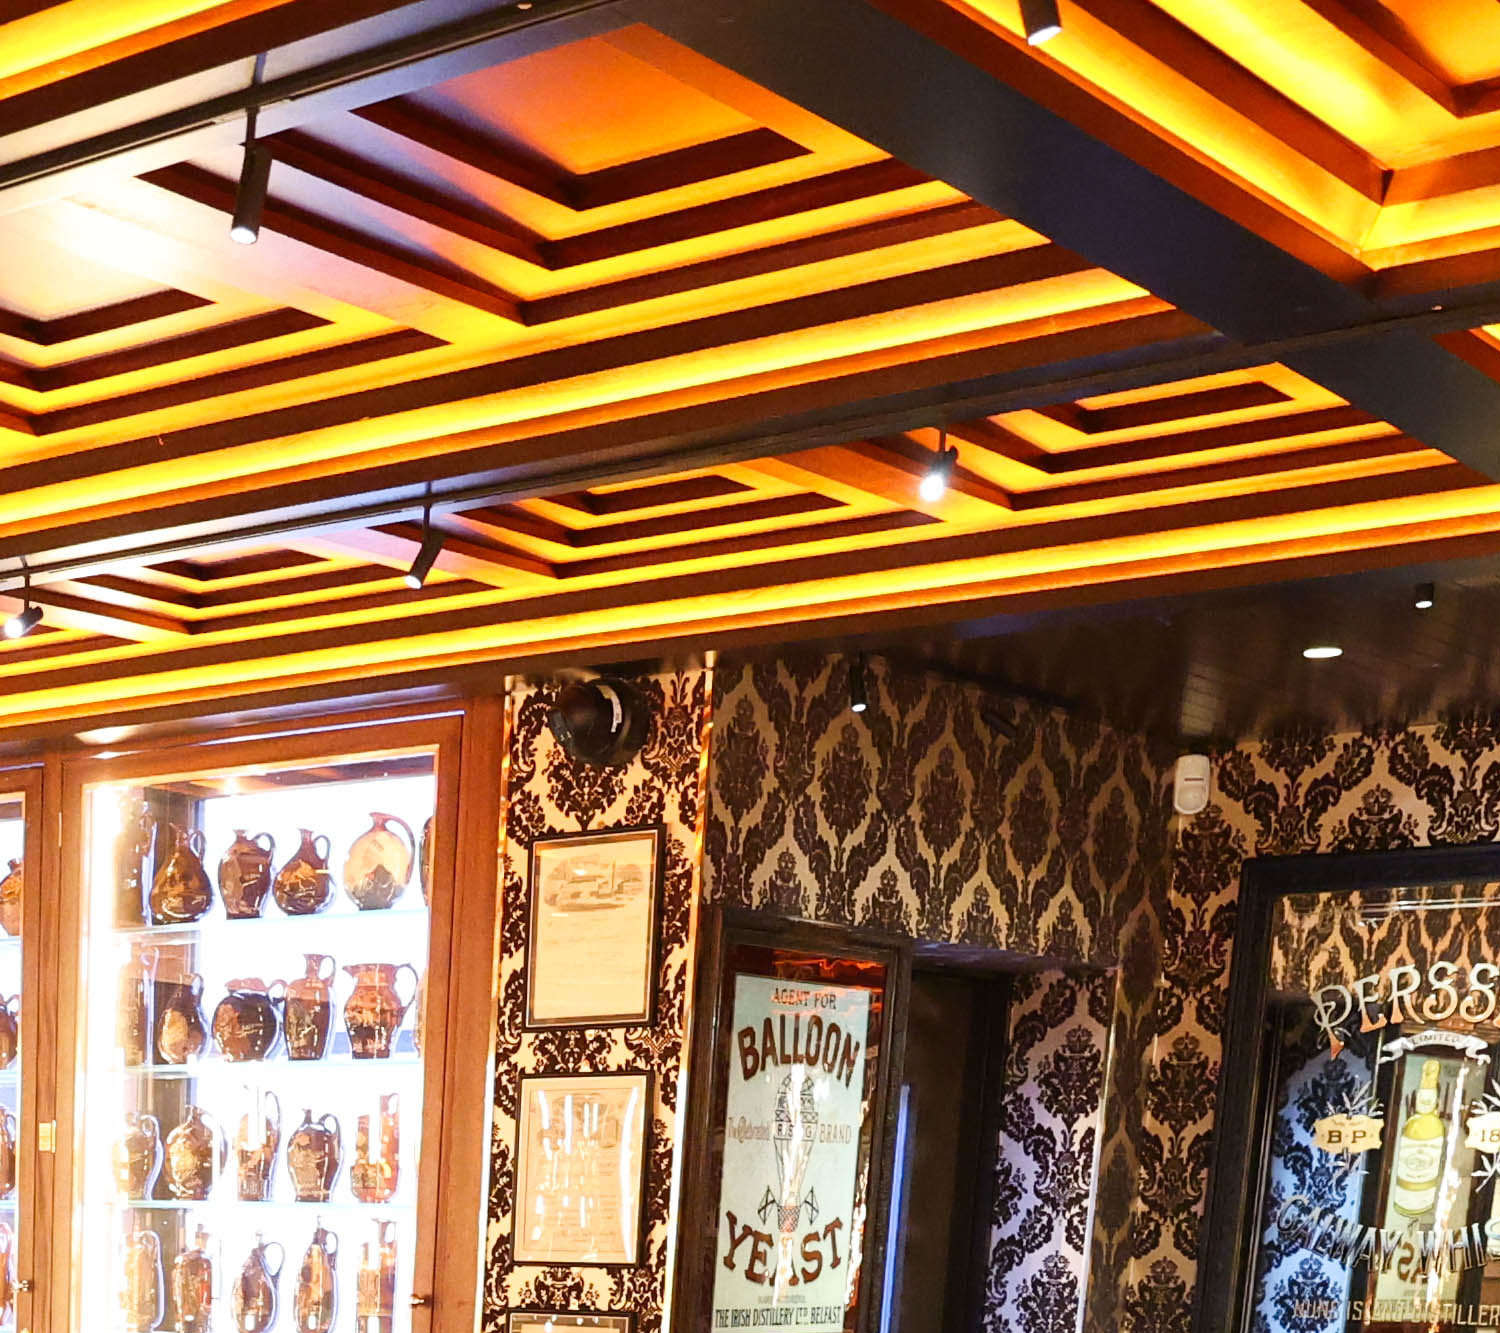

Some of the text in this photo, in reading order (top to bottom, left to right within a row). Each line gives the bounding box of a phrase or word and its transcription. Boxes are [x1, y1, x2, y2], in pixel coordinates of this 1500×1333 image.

[773, 987, 837, 1010] AGENT FOR
[737, 1013, 861, 1089] BALLOON
[819, 1123, 852, 1145] BRAND
[1276, 1195, 1403, 1275] GALWAY
[715, 1308, 729, 1328] THE
[731, 1308, 751, 1328] IRISH
[752, 1307, 795, 1327] DISTILLERY
[810, 1306, 842, 1325] BELFAST
